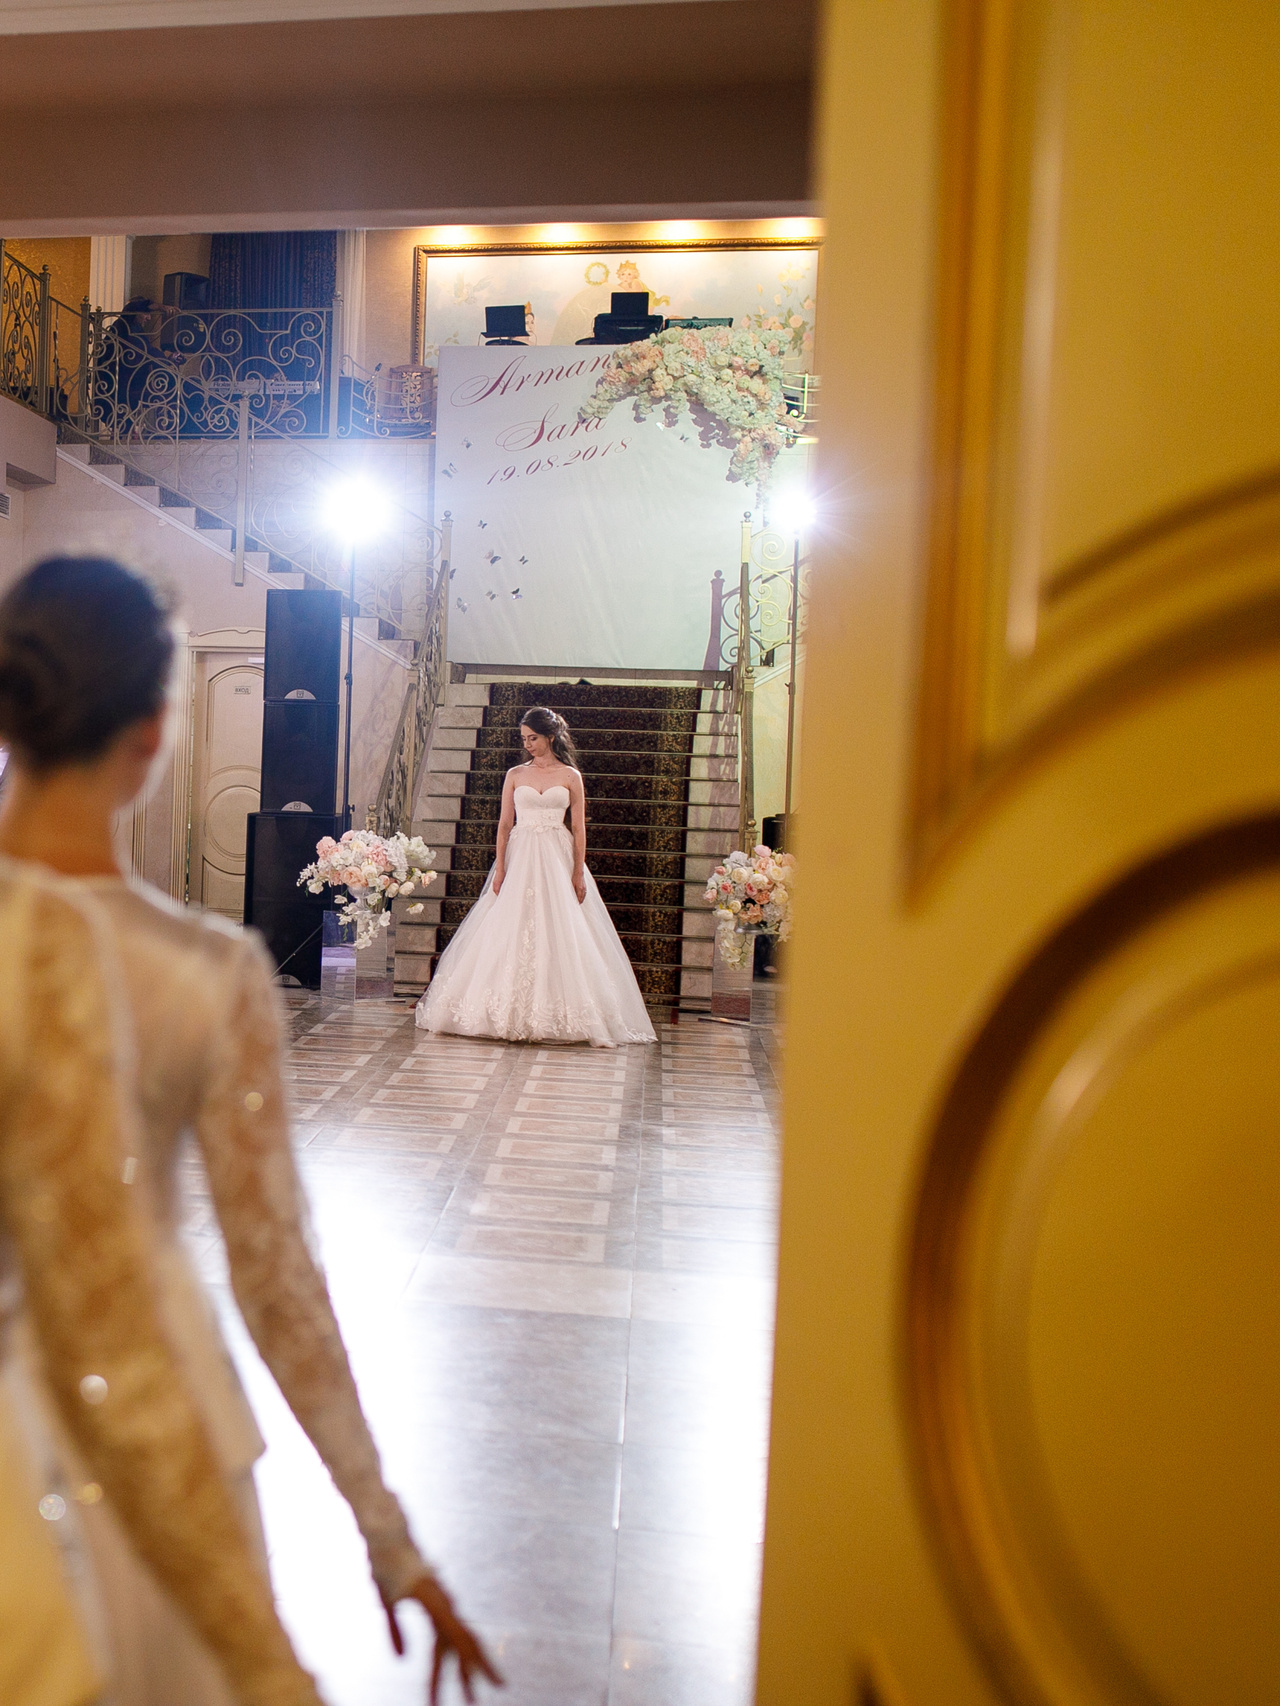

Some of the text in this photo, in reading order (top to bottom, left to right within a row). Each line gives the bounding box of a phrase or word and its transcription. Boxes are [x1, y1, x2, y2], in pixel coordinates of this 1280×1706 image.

[450, 354, 611, 408] Arman
[495, 402, 608, 452] Sara
[486, 437, 632, 485] 19.08.2018
